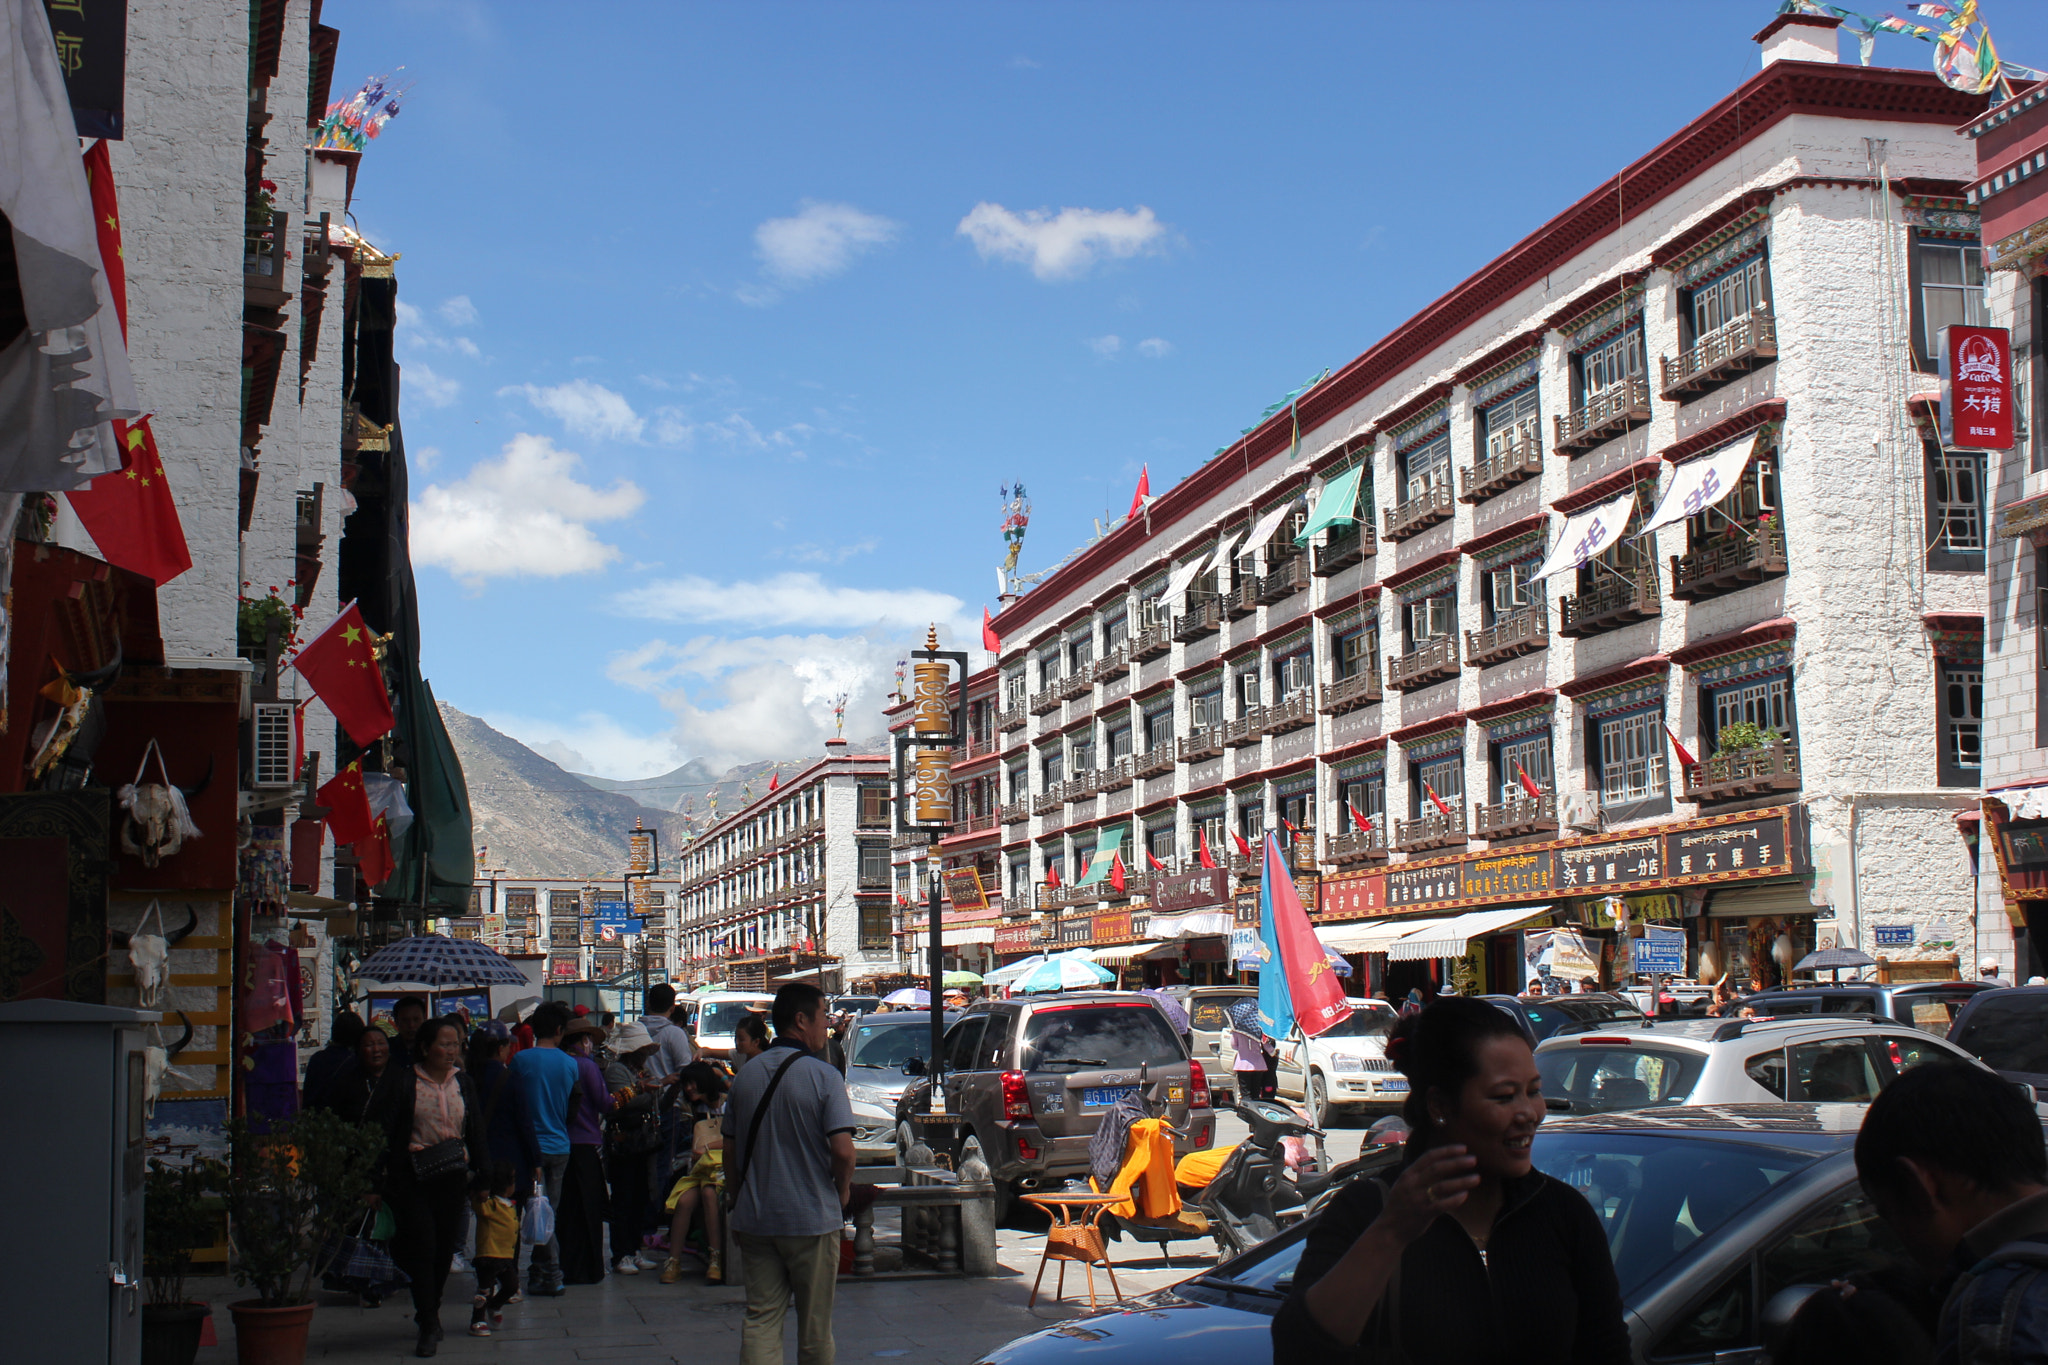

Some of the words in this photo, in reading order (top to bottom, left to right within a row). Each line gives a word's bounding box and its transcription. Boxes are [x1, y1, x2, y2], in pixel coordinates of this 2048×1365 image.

[1969, 372, 1991, 382] cafe
[1680, 844, 1772, 875] 爱不释手
